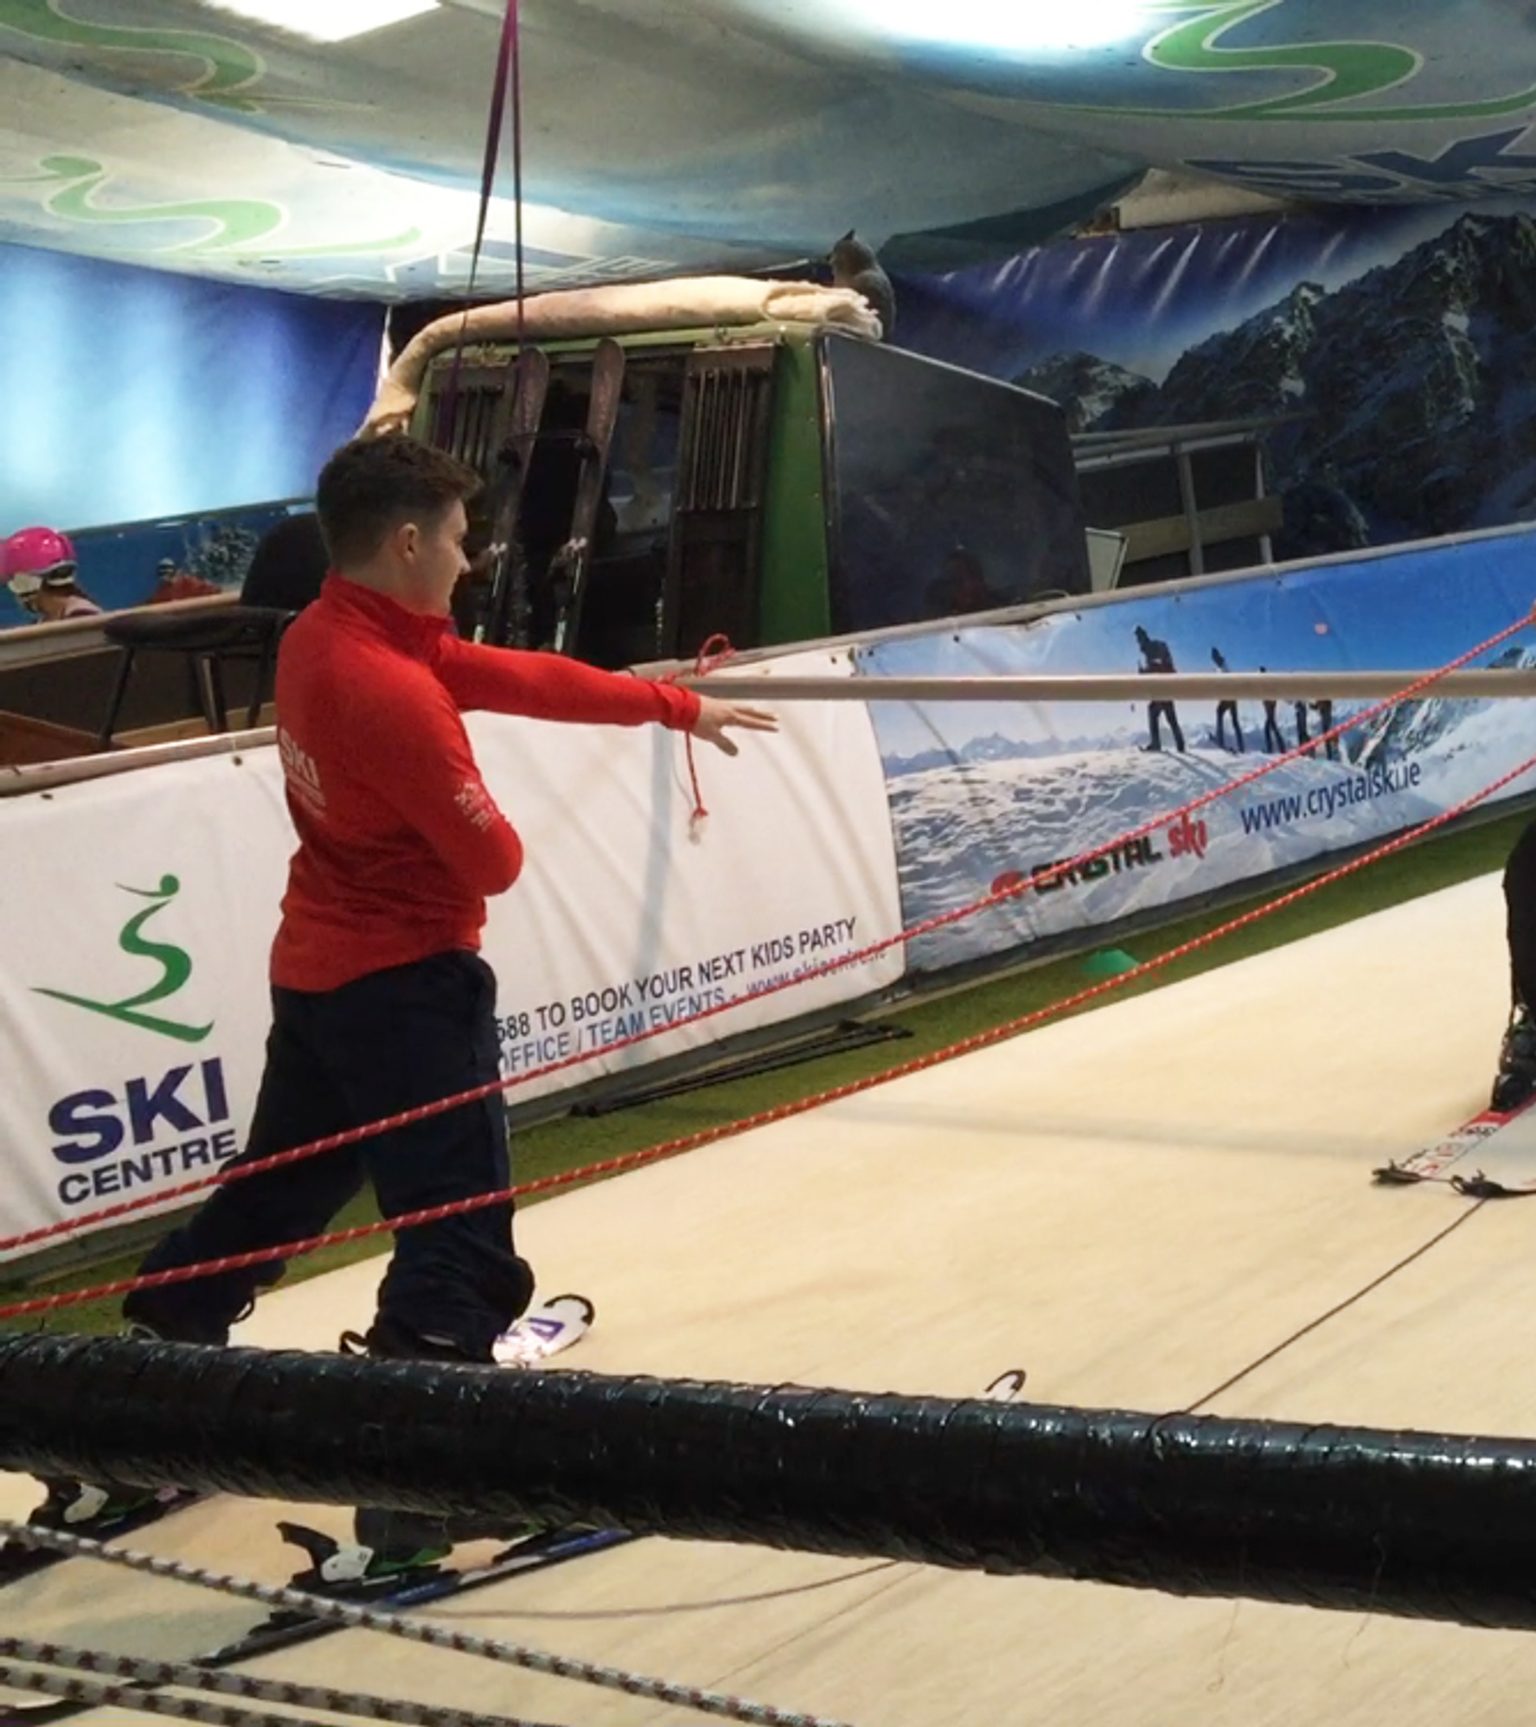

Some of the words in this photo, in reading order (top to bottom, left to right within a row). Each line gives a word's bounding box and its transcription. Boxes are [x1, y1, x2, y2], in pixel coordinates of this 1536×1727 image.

[280, 727, 320, 790] SKI
[1240, 760, 1422, 835] www.crystalski.ie
[535, 1002, 566, 1031] TO
[571, 984, 633, 1022] BOOK
[635, 966, 694, 1002] YOUR
[698, 949, 746, 986] NEXT
[751, 934, 795, 970] KIDS
[799, 916, 857, 954] PARTY
[587, 1010, 646, 1047] TEAM
[649, 986, 726, 1030] EVENTS
[48, 1056, 229, 1165] SKI
[57, 1128, 238, 1206] CENTRE
